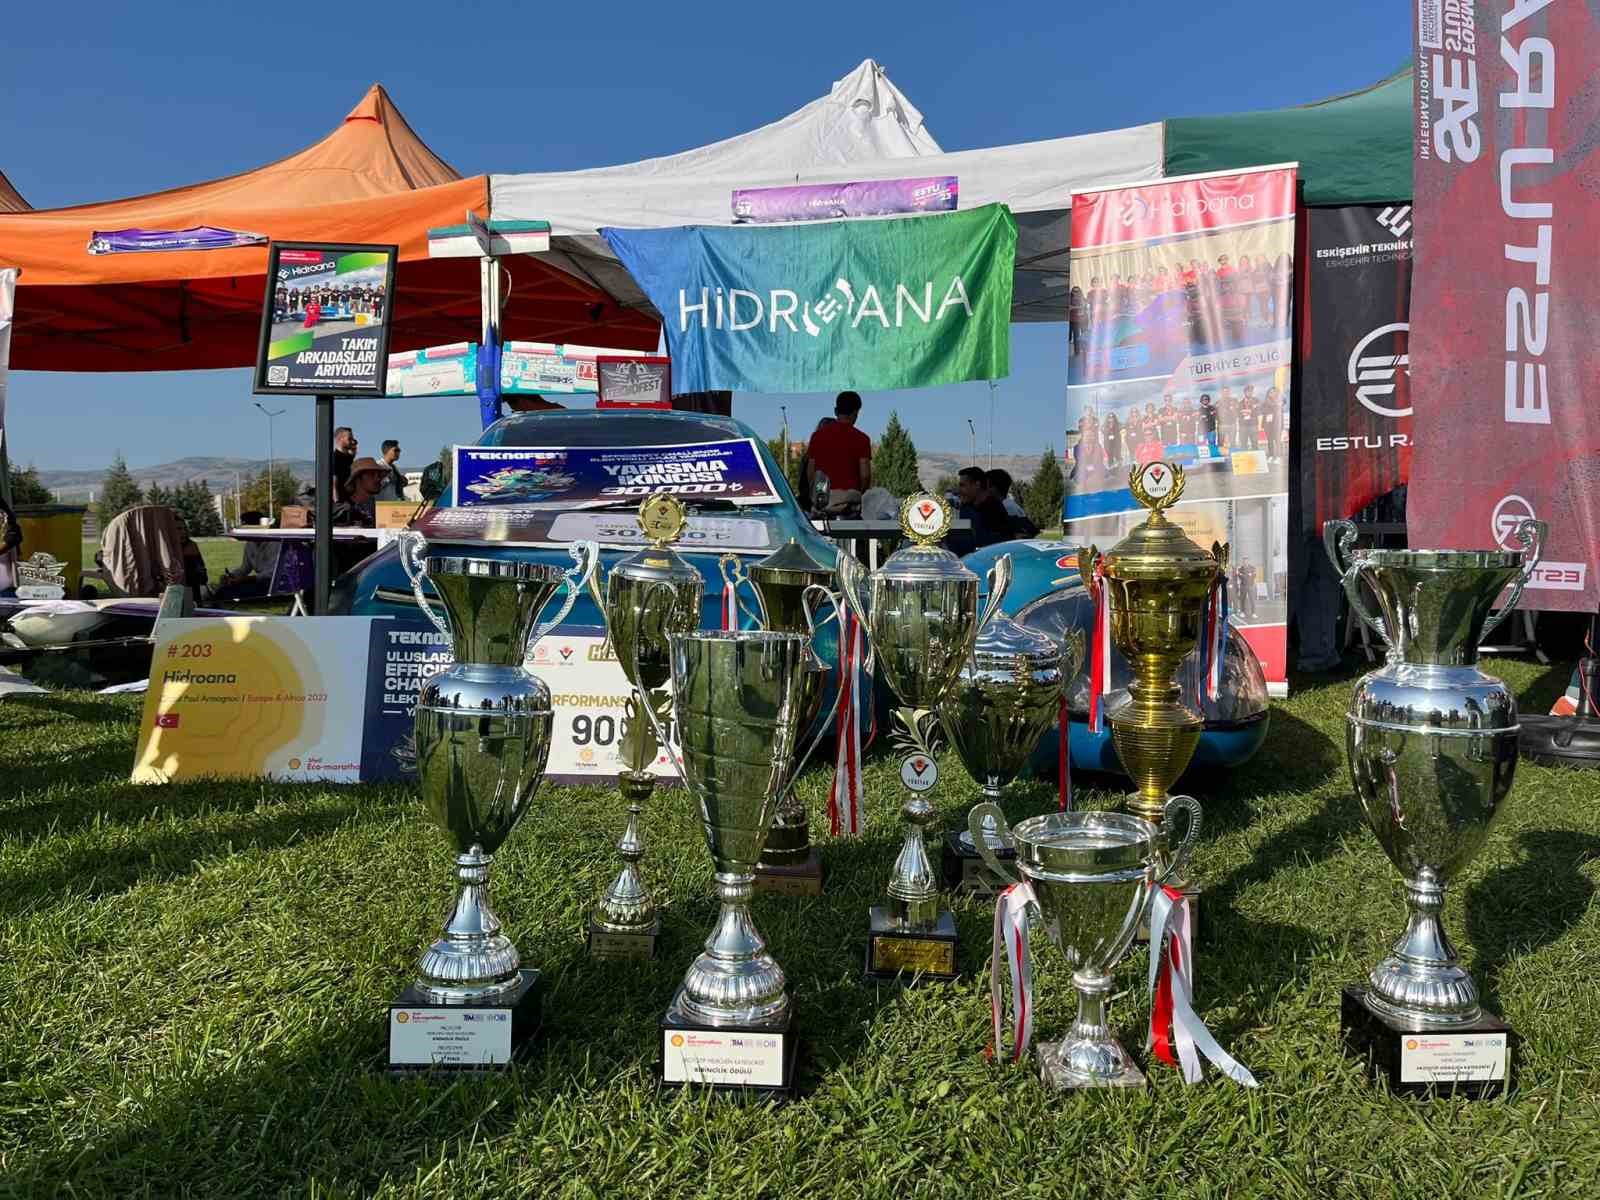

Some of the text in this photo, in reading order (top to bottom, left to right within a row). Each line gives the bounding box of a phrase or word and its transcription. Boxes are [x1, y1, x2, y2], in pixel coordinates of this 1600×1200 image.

[342, 338, 377, 350] TAKIM
[296, 350, 377, 364] ARKADAŞLARI
[315, 363, 377, 376] ARIYORUZ!
[1316, 435, 1382, 451] ESTU
[468, 452, 567, 460] TEKNOFEST
[180, 643, 212, 658] 203
[162, 669, 237, 684] Hidroana
[384, 677, 425, 691] CHA
[383, 694, 420, 704] ELEKT
